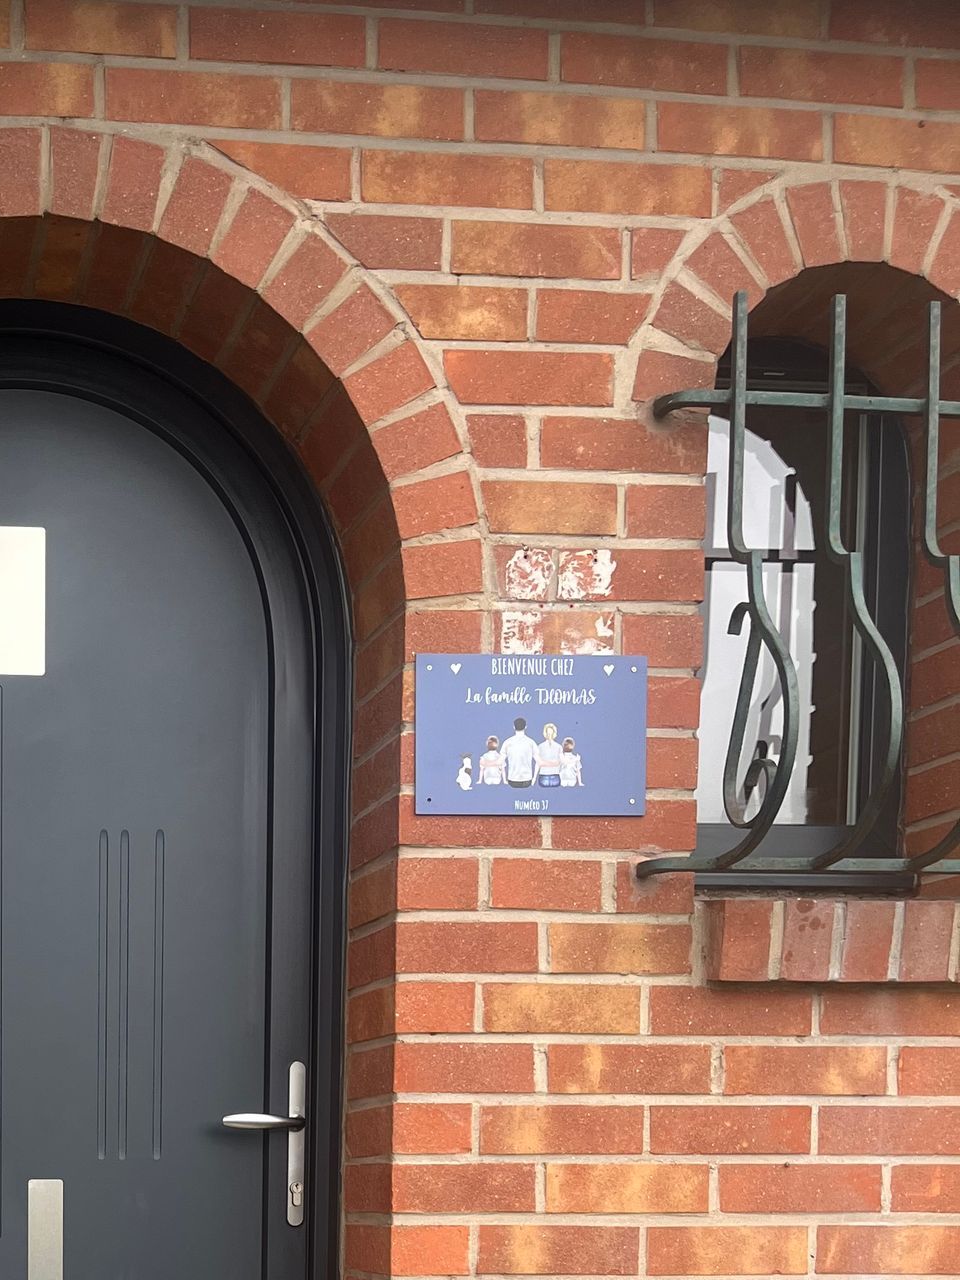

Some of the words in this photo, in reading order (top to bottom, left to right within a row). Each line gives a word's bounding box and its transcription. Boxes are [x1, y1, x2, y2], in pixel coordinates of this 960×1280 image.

[491, 658, 547, 675] BIENVENUE
[551, 658, 574, 676] CHEZ
[465, 687, 483, 703] La
[485, 686, 532, 705] famille
[535, 688, 596, 705] THOMAS
[541, 799, 549, 811] 37
